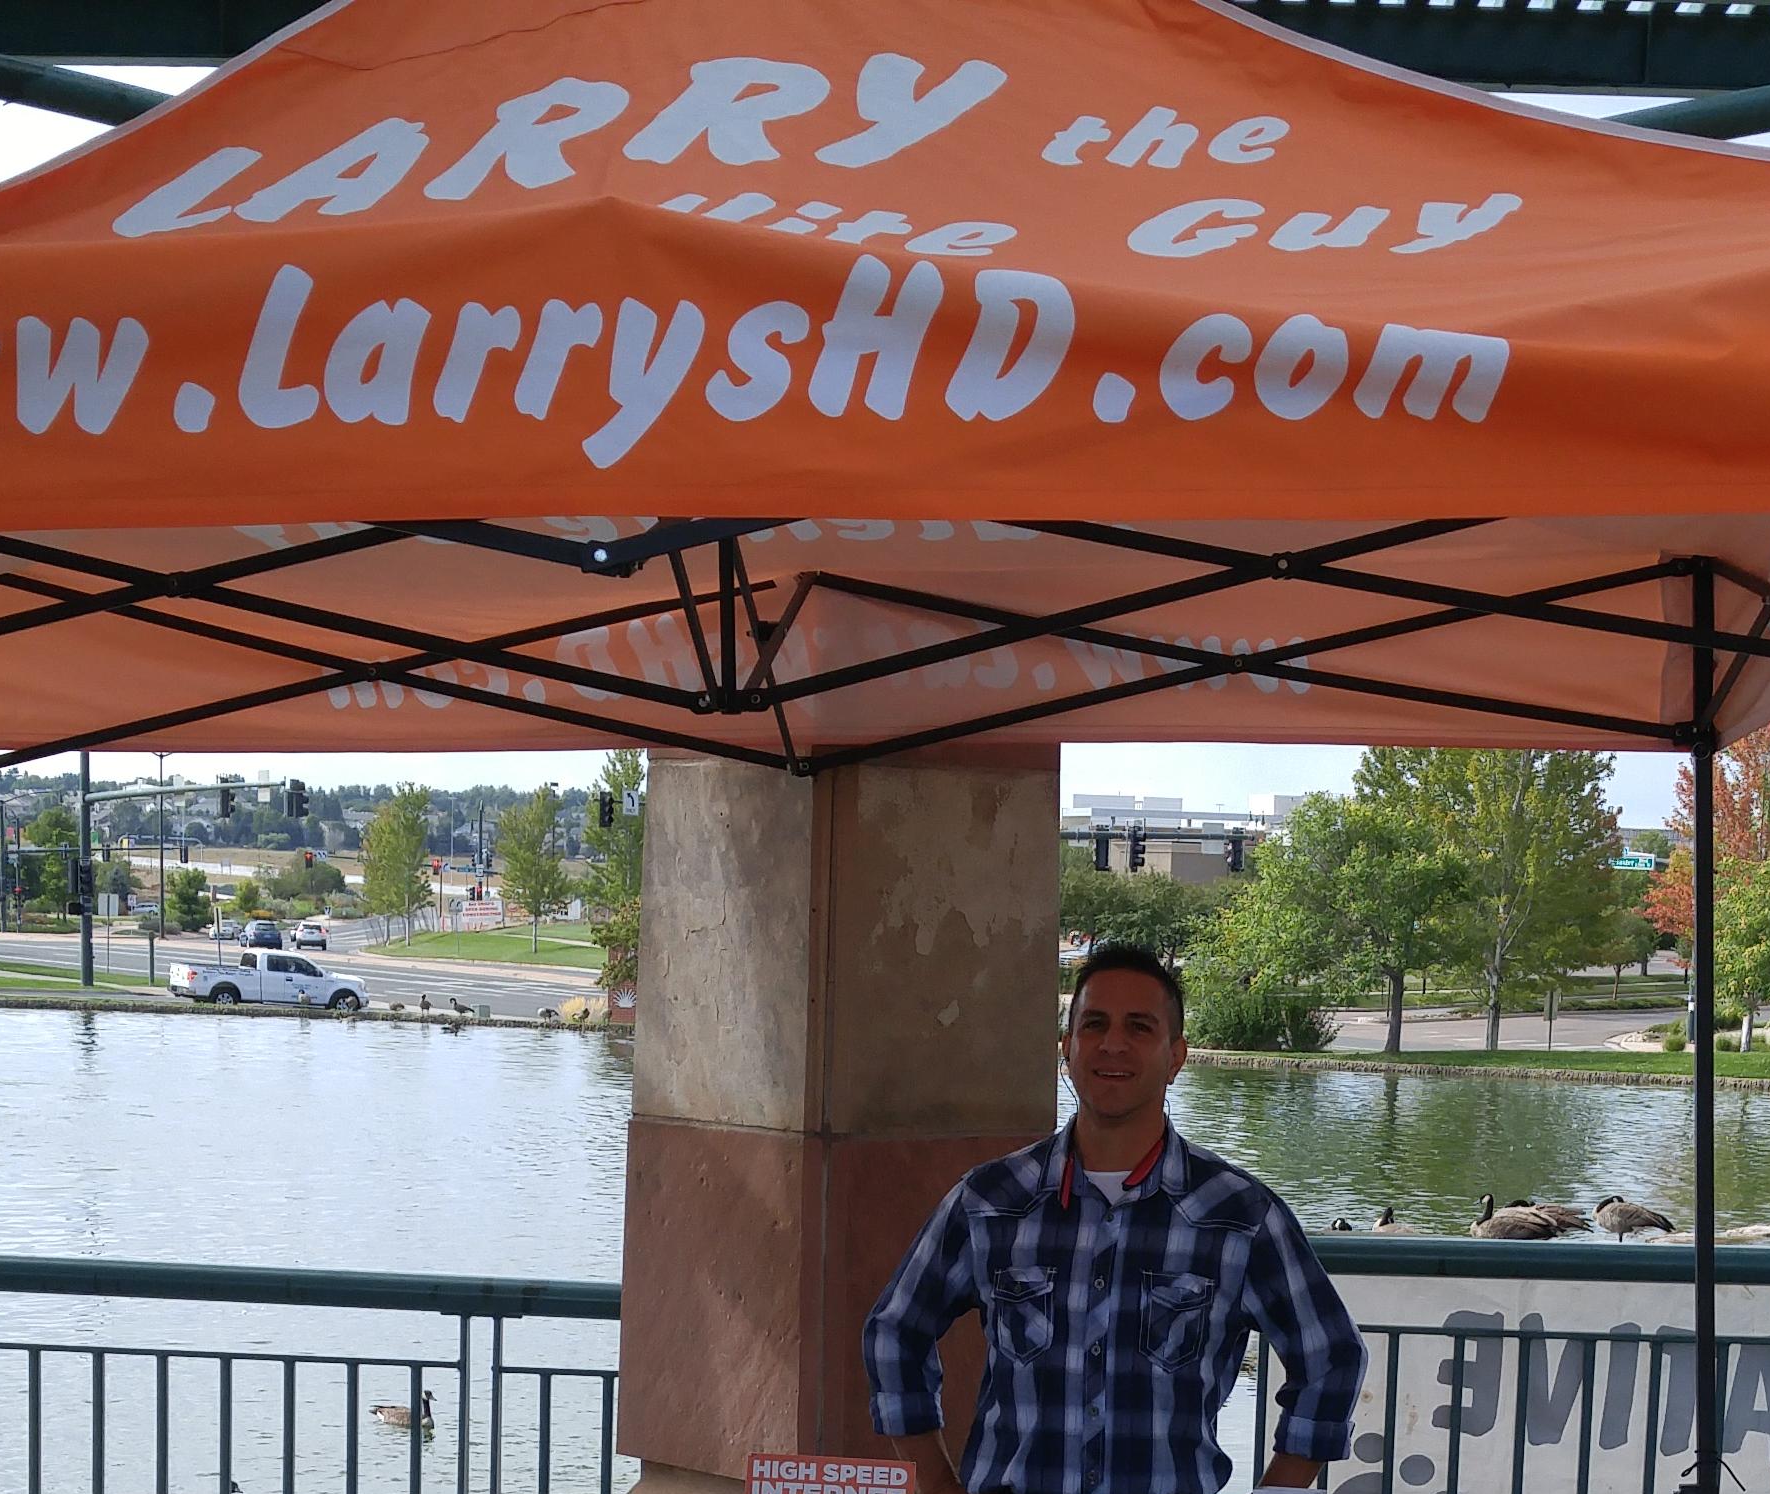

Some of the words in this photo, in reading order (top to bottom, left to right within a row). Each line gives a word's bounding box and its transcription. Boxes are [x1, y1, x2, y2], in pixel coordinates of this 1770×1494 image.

[111, 51, 1010, 240] LARRY
[1040, 105, 1291, 170] the
[1125, 192, 1524, 261] Guy
[752, 1460, 817, 1481] HIGH
[822, 1463, 908, 1486] SPEED
